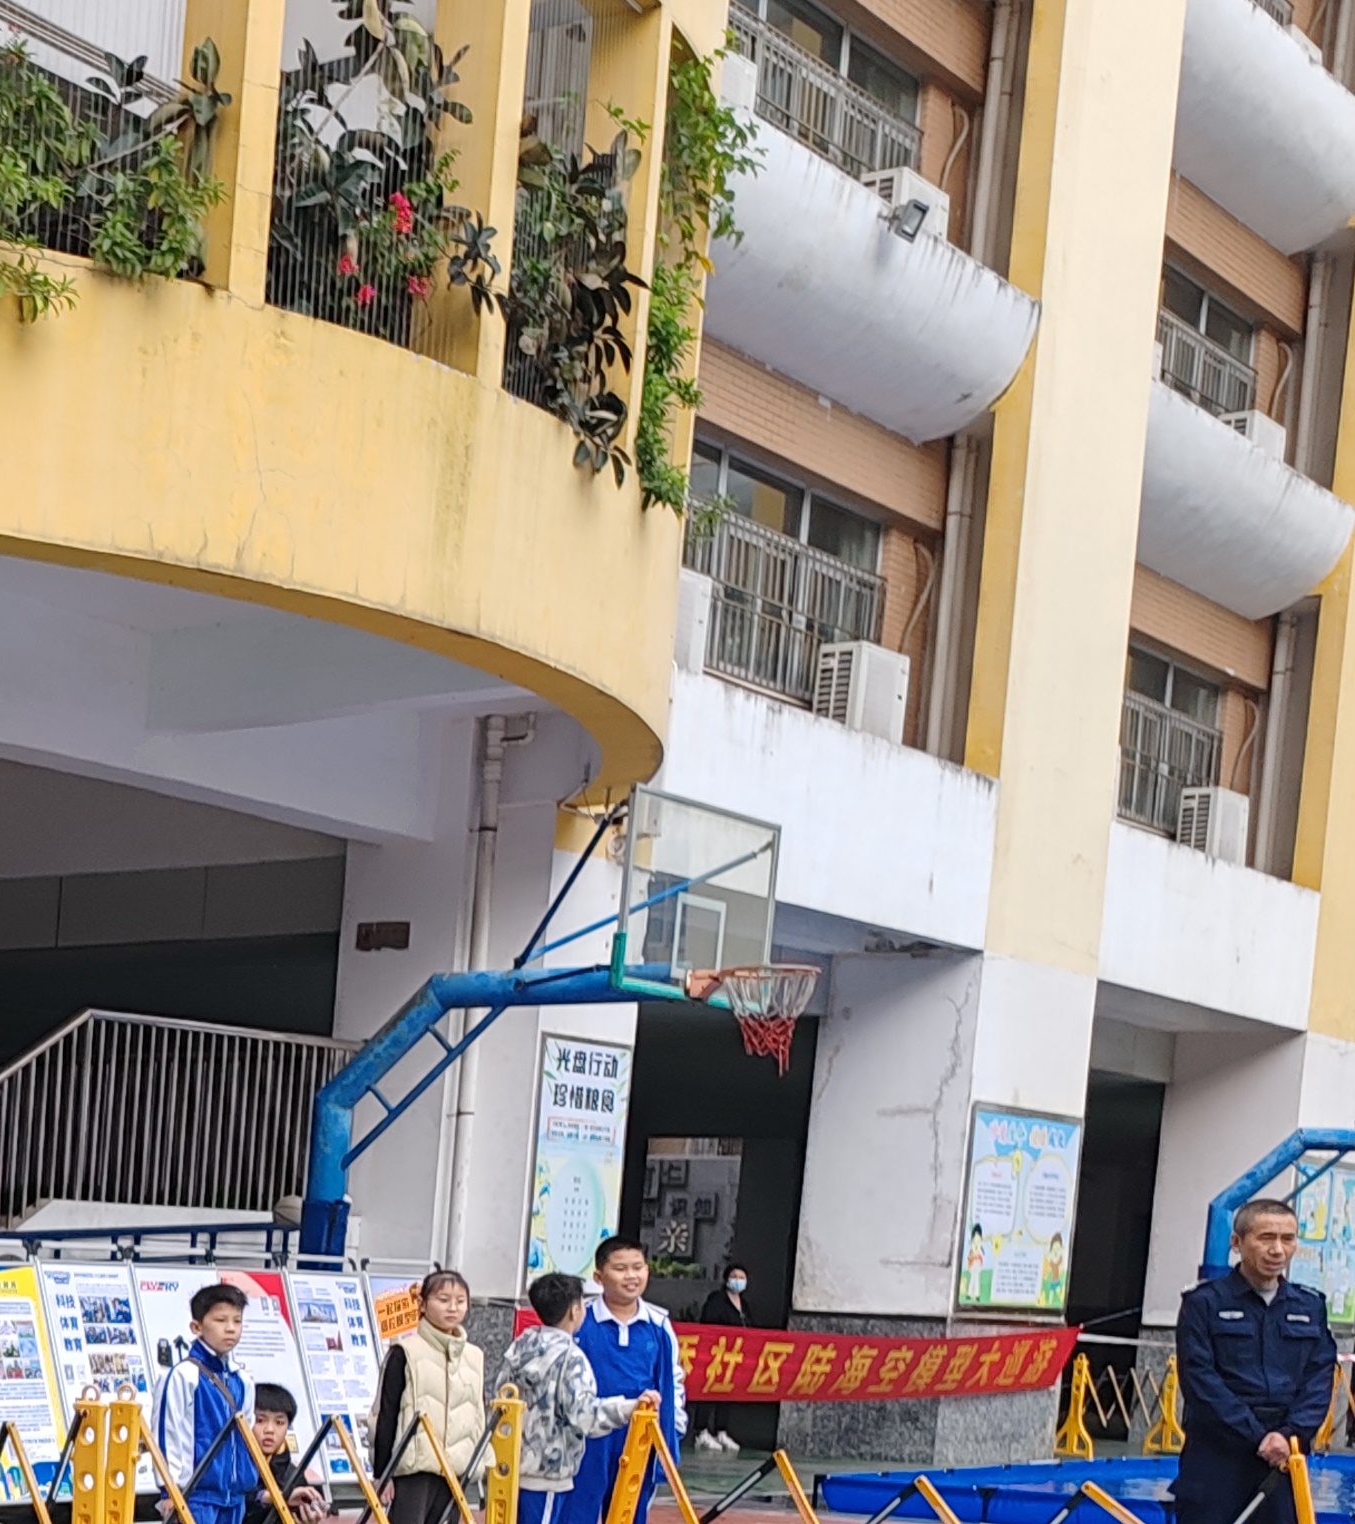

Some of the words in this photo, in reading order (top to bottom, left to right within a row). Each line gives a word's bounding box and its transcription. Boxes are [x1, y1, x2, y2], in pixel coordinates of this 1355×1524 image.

[556, 1047, 619, 1079] 光盘行动
[553, 1083, 615, 1114] 珍惜粮食
[55, 1294, 76, 1309] 科技
[344, 1298, 361, 1311] 科技
[59, 1316, 79, 1331] 体育
[347, 1316, 364, 1330] 体育
[64, 1338, 83, 1352] 教育
[350, 1334, 368, 1347] 教育
